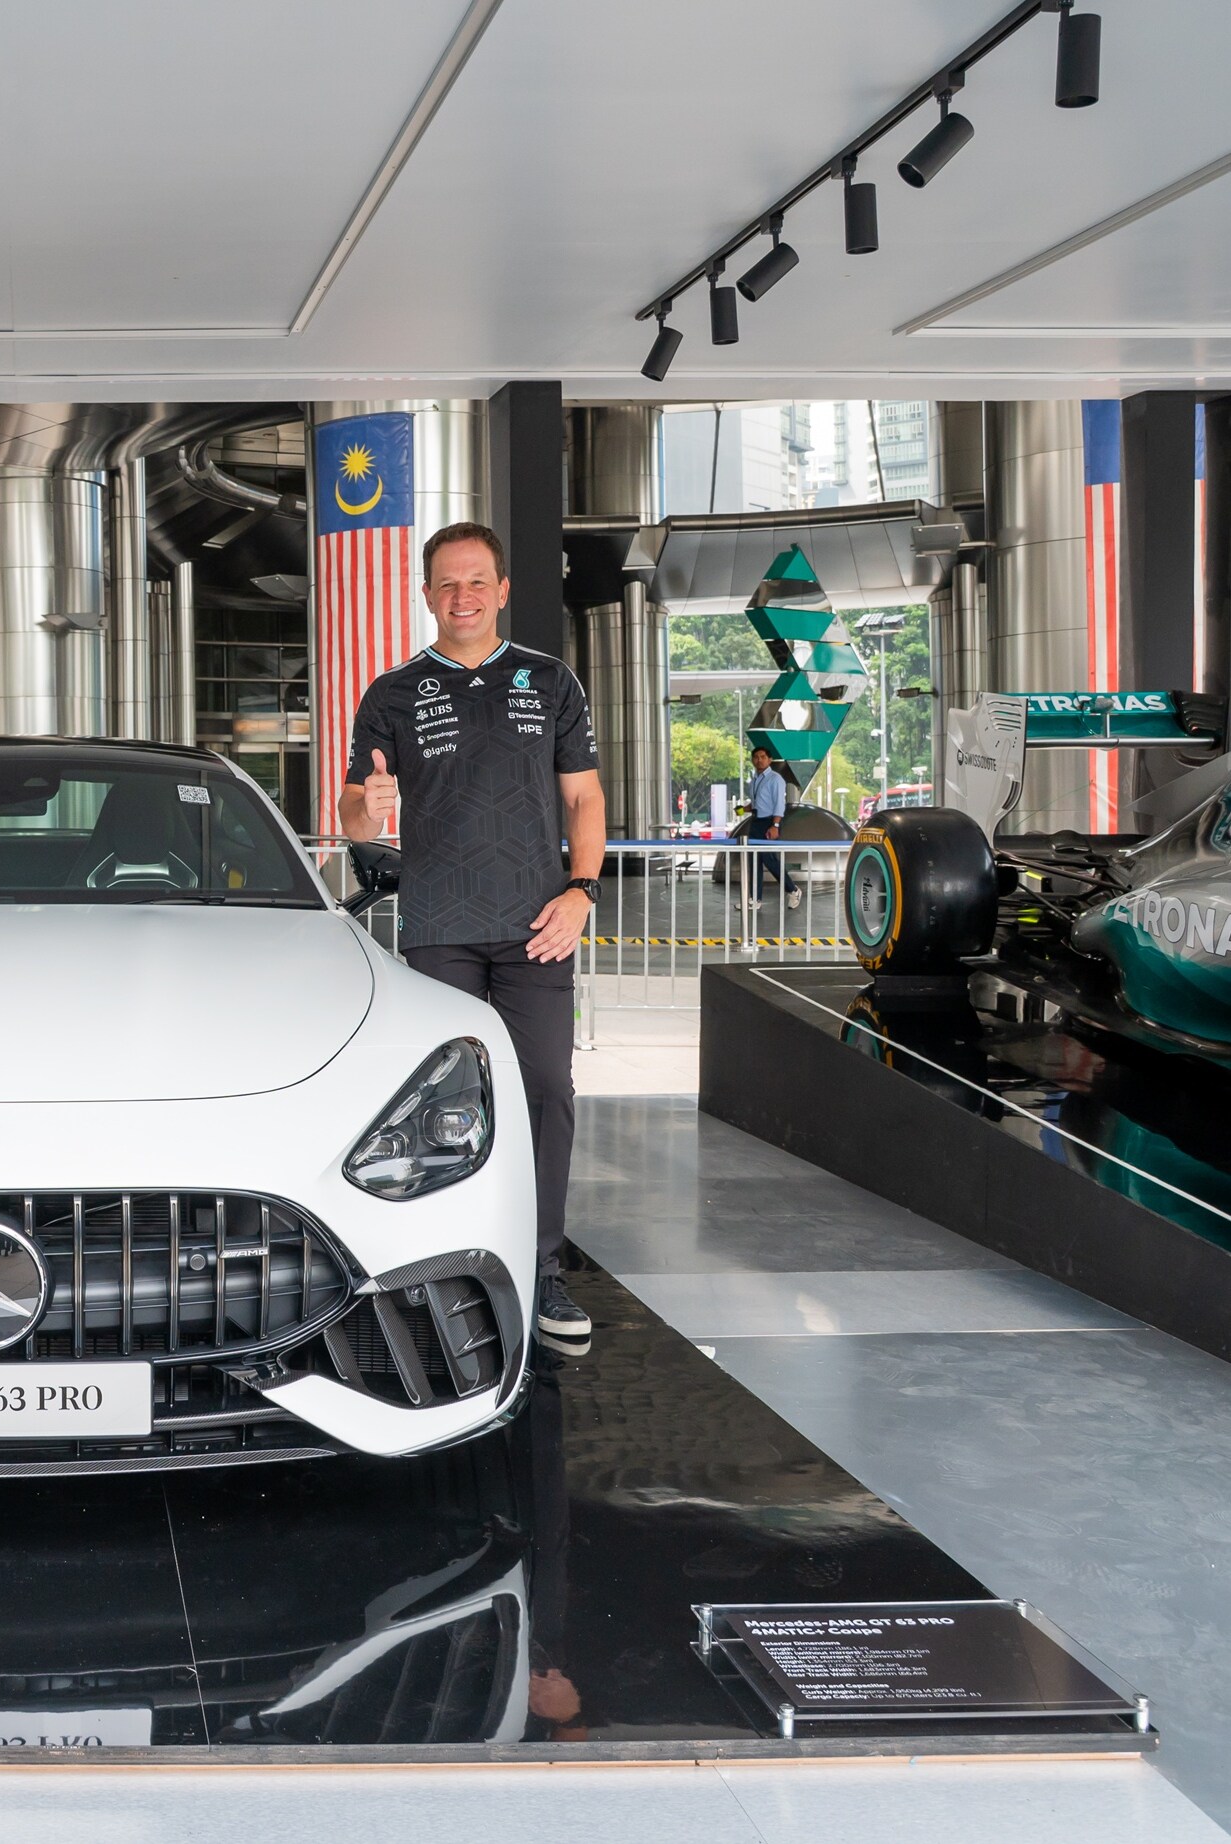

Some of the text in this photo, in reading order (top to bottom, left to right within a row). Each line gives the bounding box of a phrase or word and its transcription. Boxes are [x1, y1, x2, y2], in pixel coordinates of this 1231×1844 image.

[429, 703, 453, 716] UBS
[508, 698, 541, 710] INEOS
[419, 716, 459, 731] CROWDSTRIKE
[426, 730, 459, 740] Snapdragon
[517, 724, 543, 735] HPE
[237, 1248, 269, 1258] AMG
[35, 1384, 104, 1412] PRO
[744, 1617, 955, 1628] Mercedes-AMG GT 63 PRO
